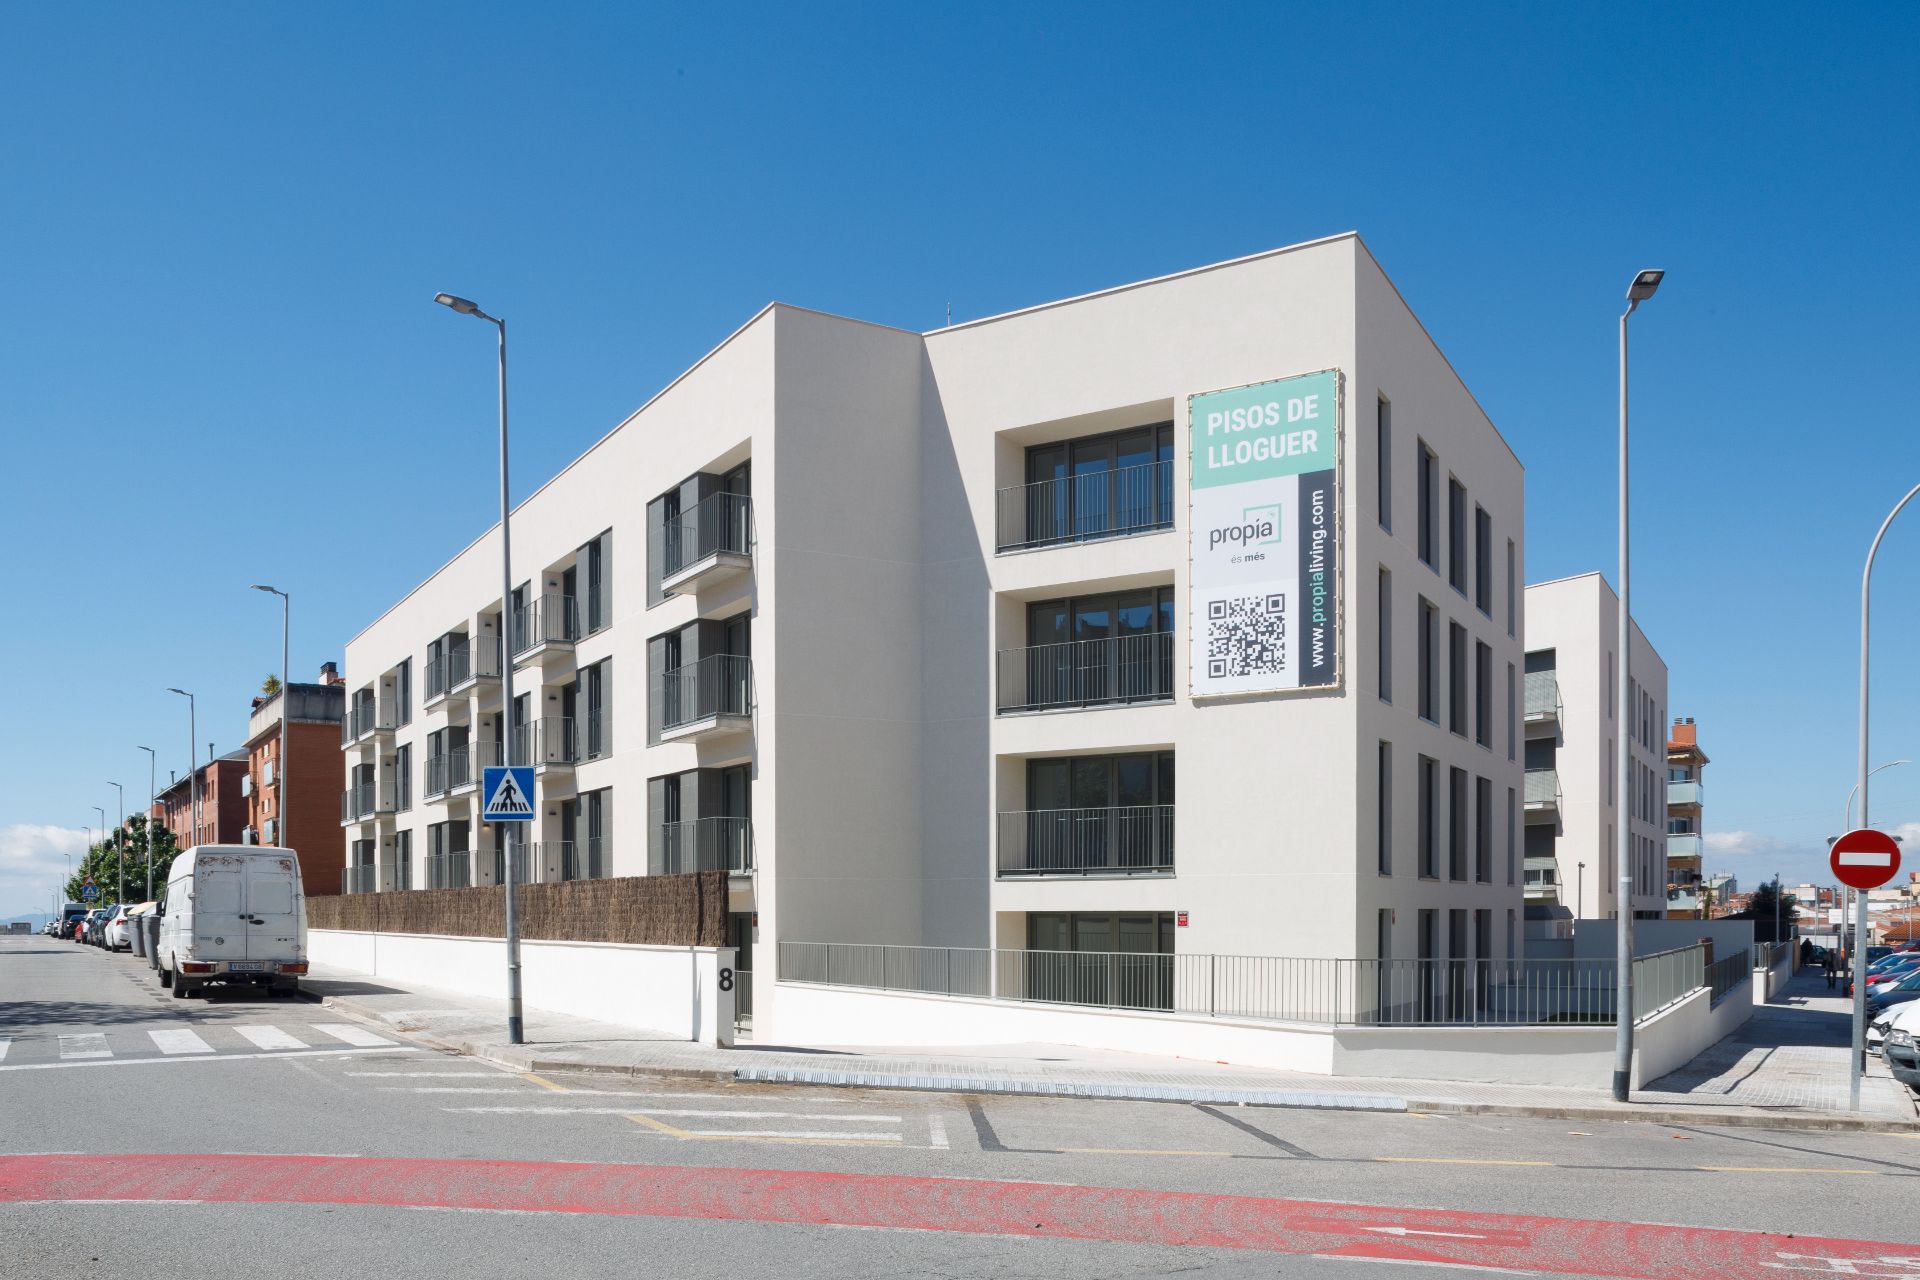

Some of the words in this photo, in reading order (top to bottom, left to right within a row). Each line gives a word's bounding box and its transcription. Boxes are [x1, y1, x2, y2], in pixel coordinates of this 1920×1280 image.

[1207, 401, 1280, 436] PISOS
[1287, 394, 1319, 423] DE
[1208, 429, 1318, 469] LLOGUER
[1244, 551, 1265, 562] més
[1309, 489, 1328, 668] www.propialiving.com
[719, 967, 734, 991] 8
